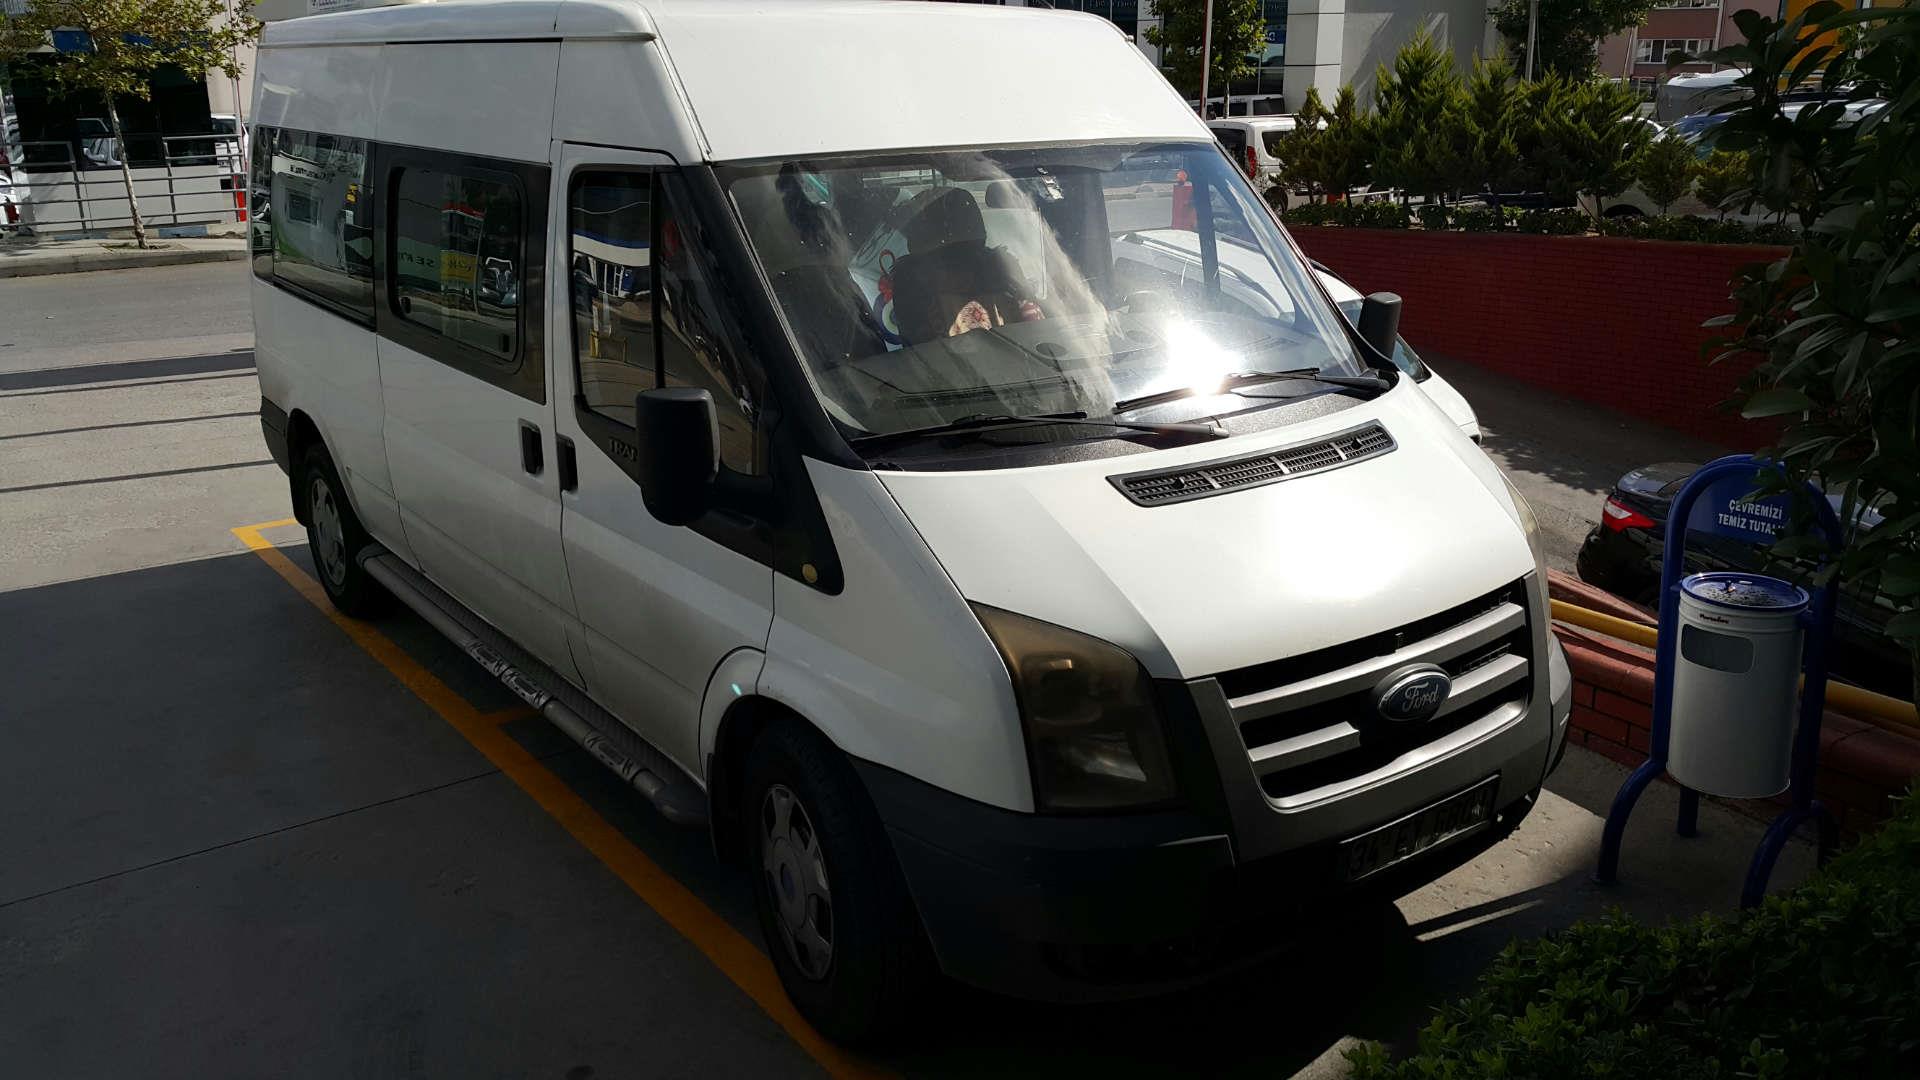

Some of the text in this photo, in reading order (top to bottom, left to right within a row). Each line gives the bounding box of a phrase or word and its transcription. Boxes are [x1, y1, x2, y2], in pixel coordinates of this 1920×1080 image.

[1729, 499, 1783, 520] ÇEVREMİZİ
[1718, 513, 1747, 529] TEMİZ
[1402, 682, 1439, 712] Ford
